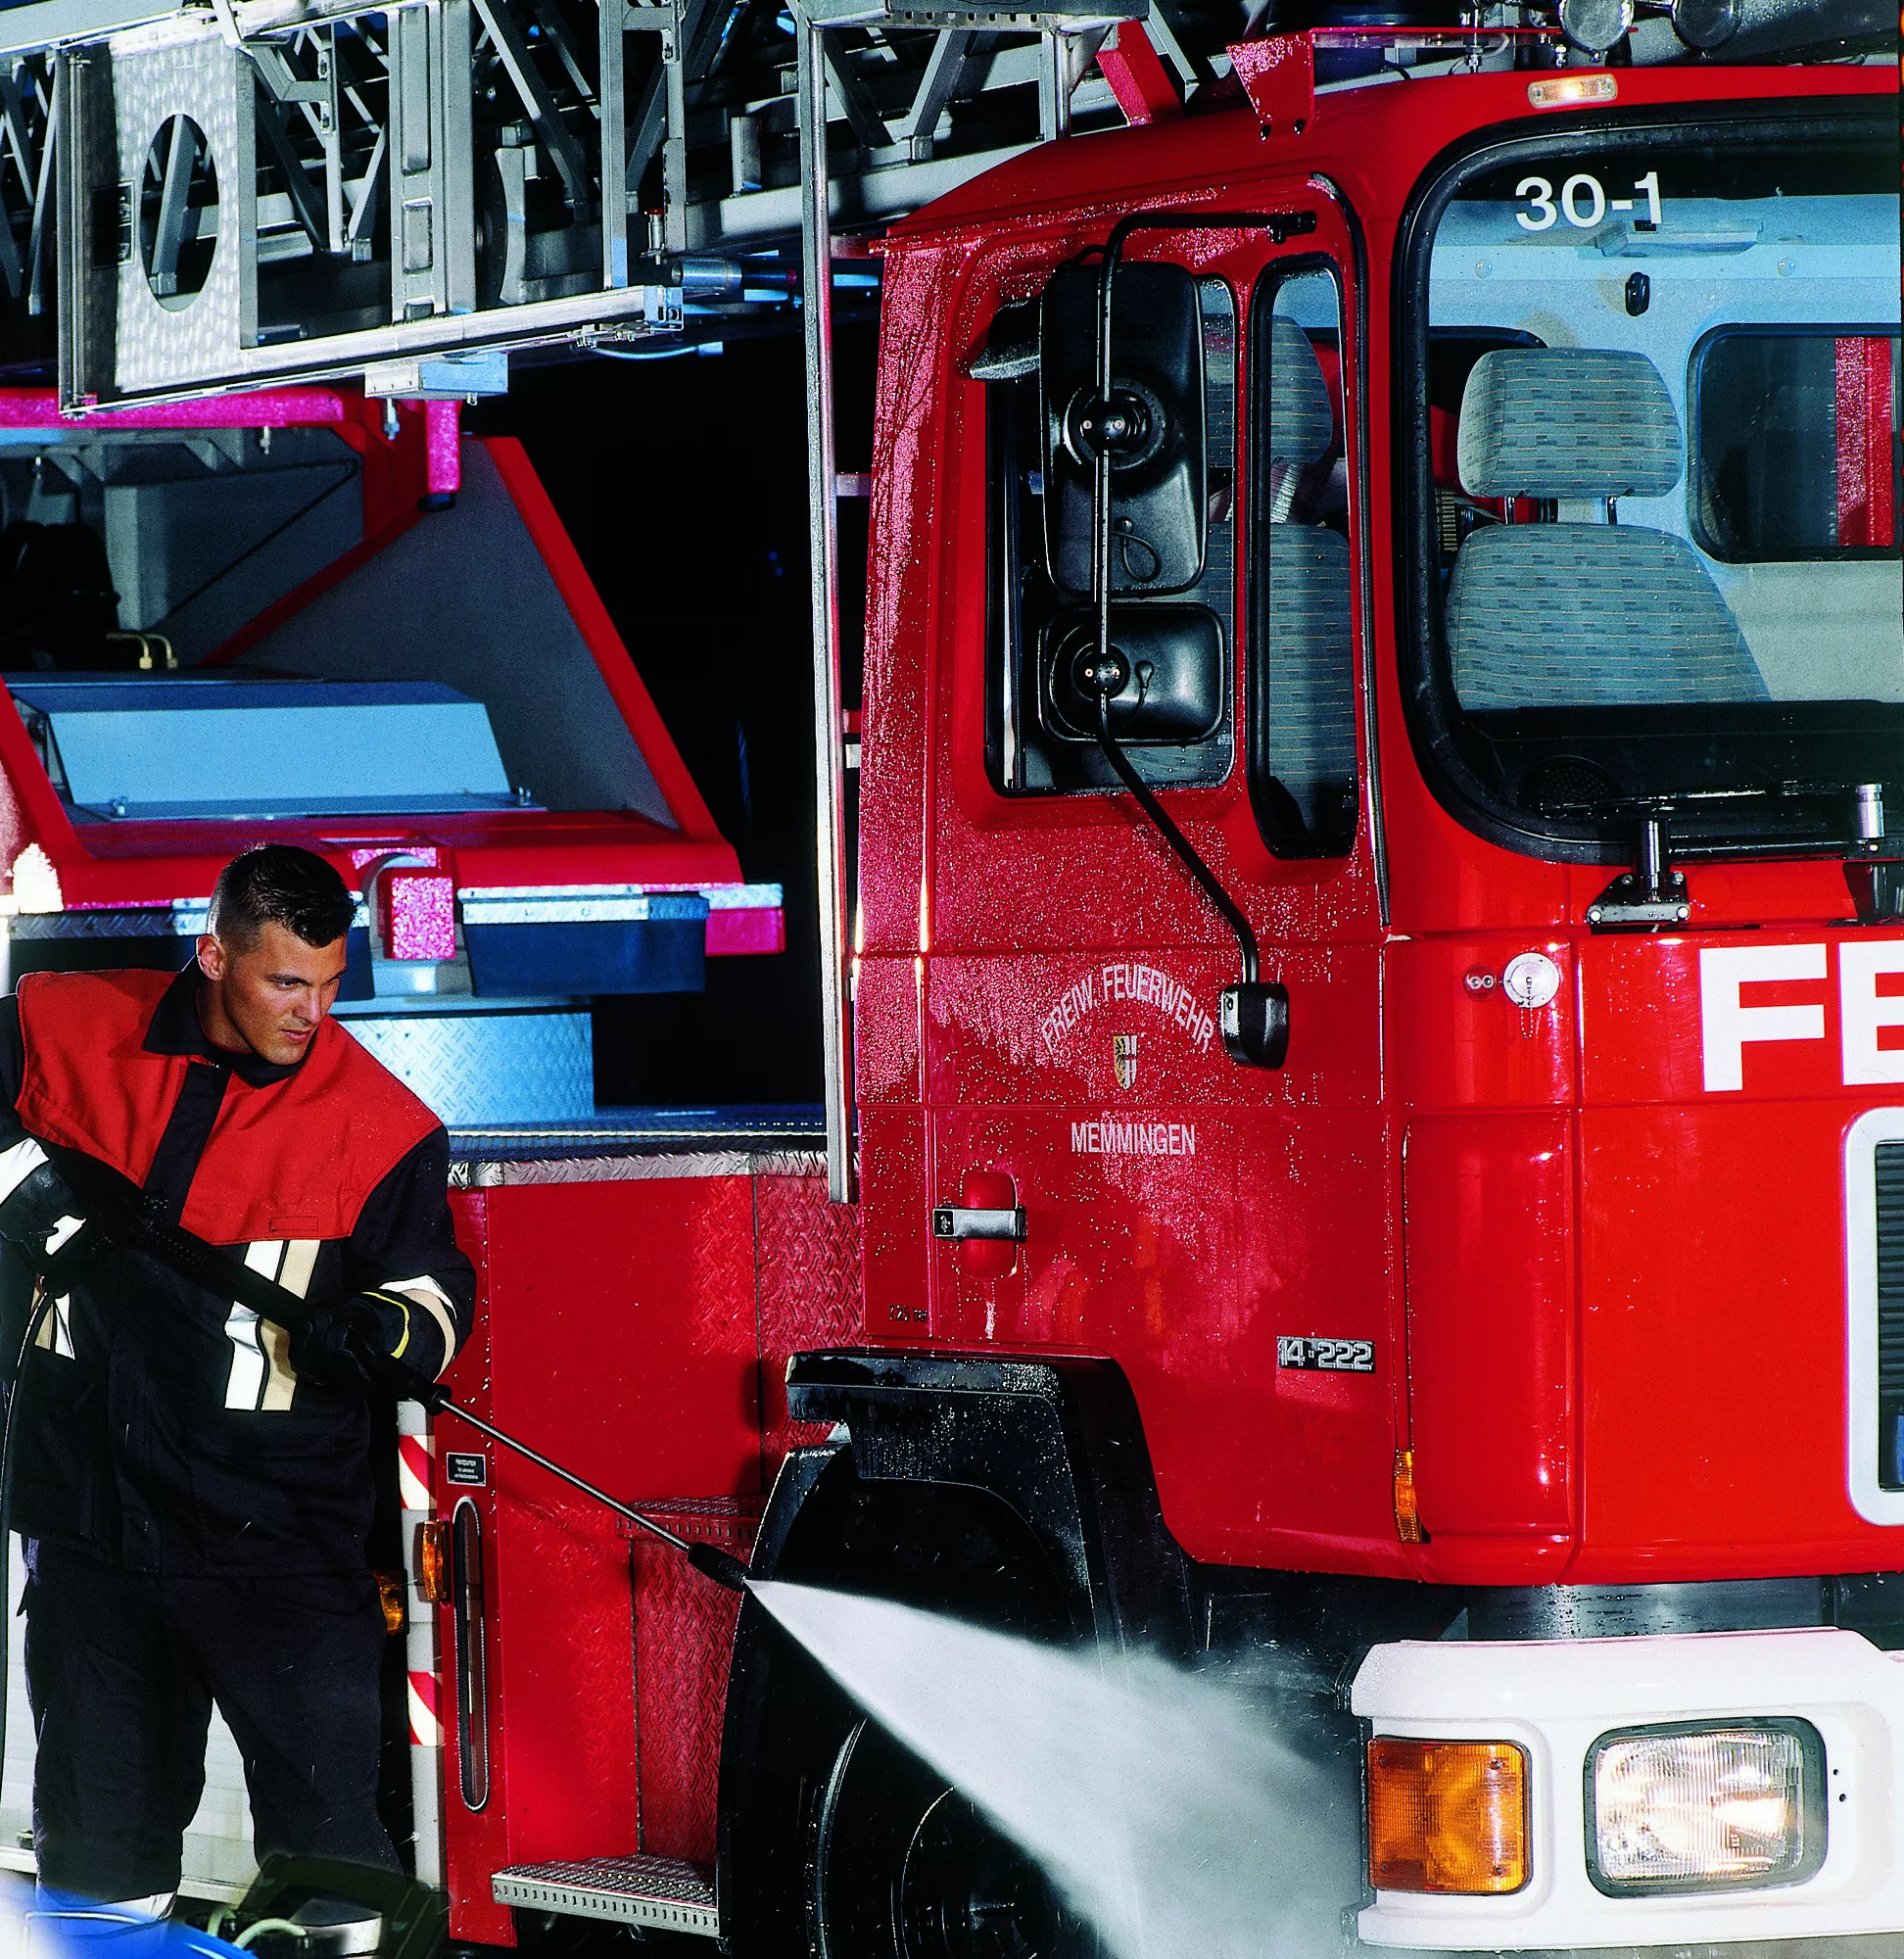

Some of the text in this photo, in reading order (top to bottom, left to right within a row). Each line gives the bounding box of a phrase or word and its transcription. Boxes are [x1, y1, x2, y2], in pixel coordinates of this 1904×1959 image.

[1515, 171, 1662, 231] 30-1
[1041, 964, 1214, 1055] FREIW. FEUERWEHR
[1071, 1122, 1196, 1156] MEMMINGEN
